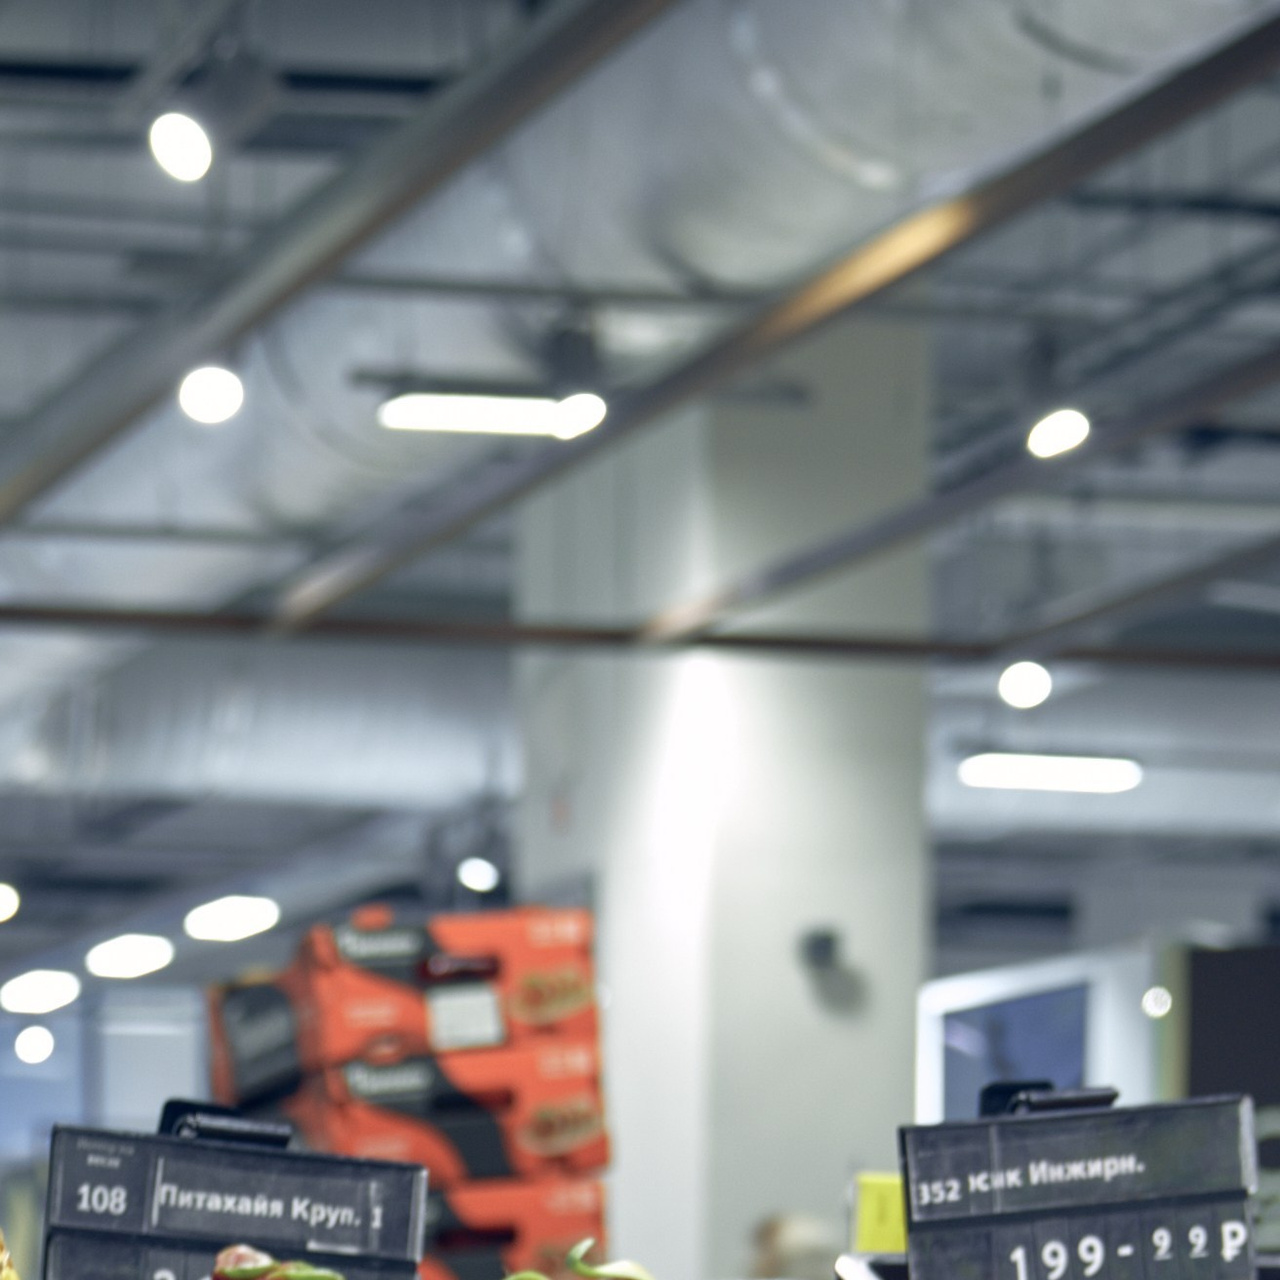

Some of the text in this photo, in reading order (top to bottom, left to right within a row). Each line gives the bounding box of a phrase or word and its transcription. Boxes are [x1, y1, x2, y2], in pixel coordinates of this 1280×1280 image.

[77, 1182, 128, 1216] 108
[158, 1182, 285, 1220] Питахайя
[291, 1196, 362, 1234] Круп.
